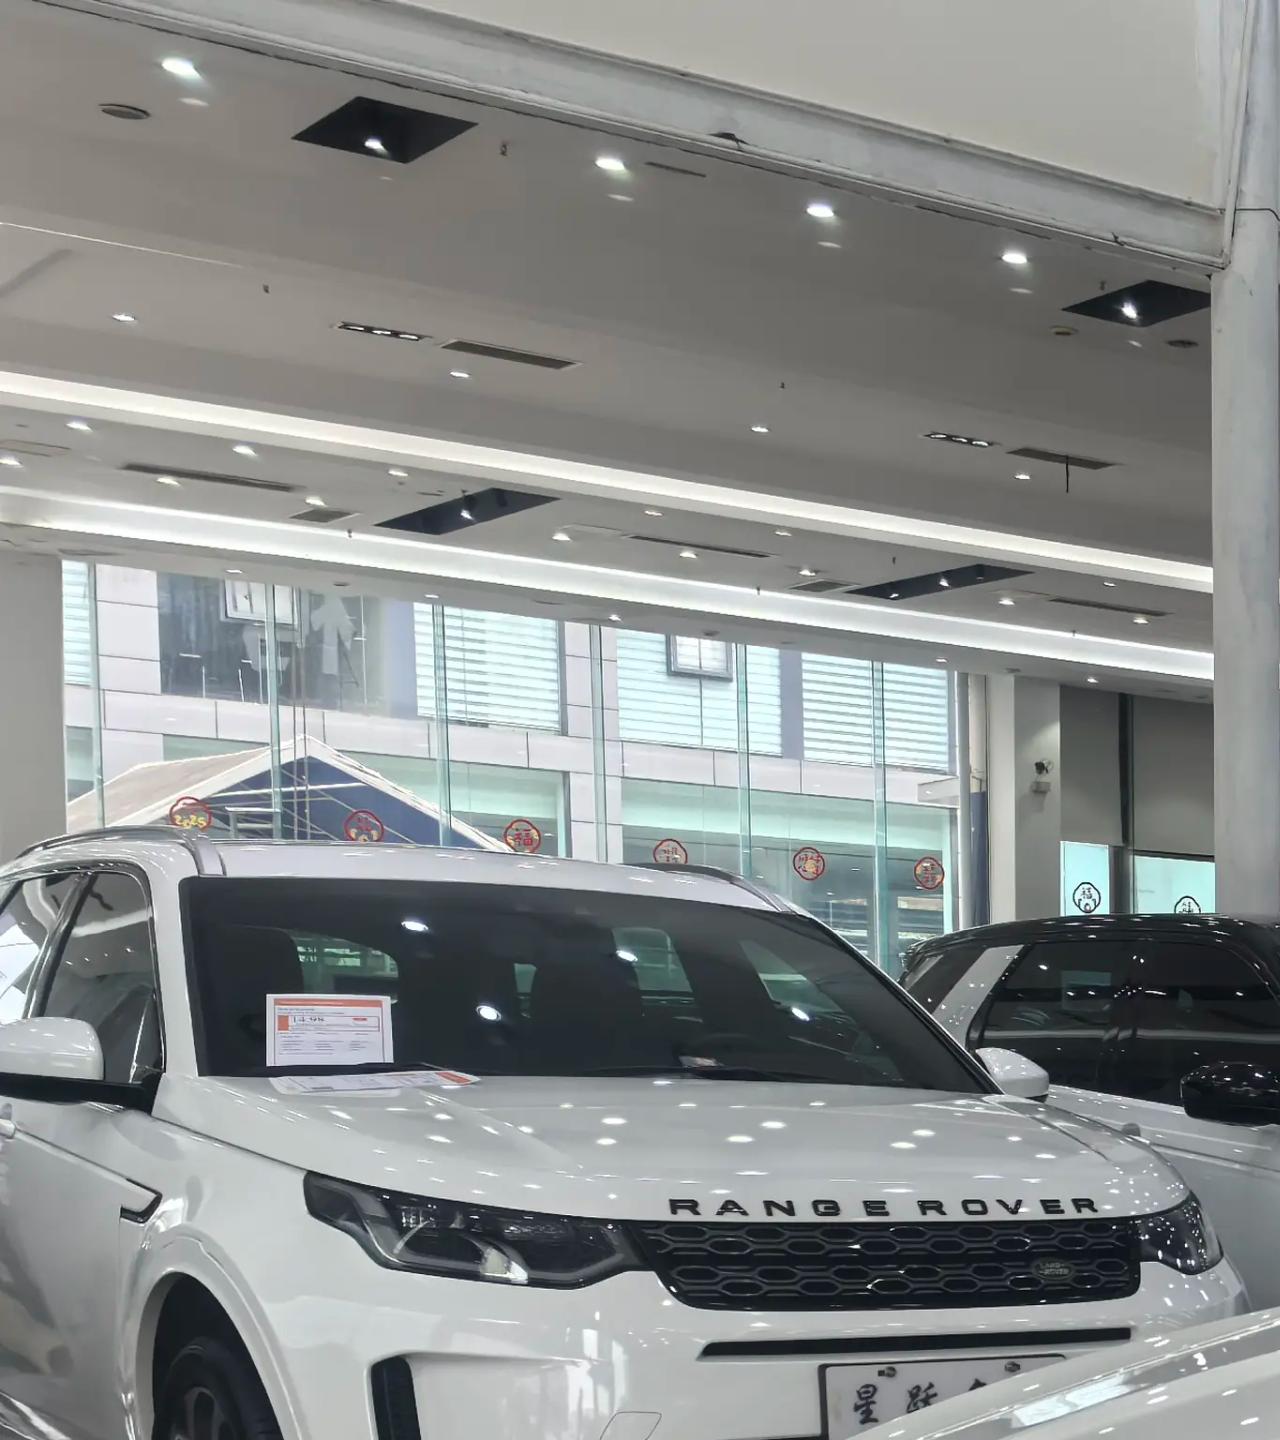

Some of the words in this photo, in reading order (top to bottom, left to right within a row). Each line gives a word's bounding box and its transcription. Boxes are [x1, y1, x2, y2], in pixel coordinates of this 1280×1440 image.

[669, 1198, 891, 1217] RANGE
[917, 1197, 1100, 1217] ROVER
[854, 1379, 987, 1425] 星跃
